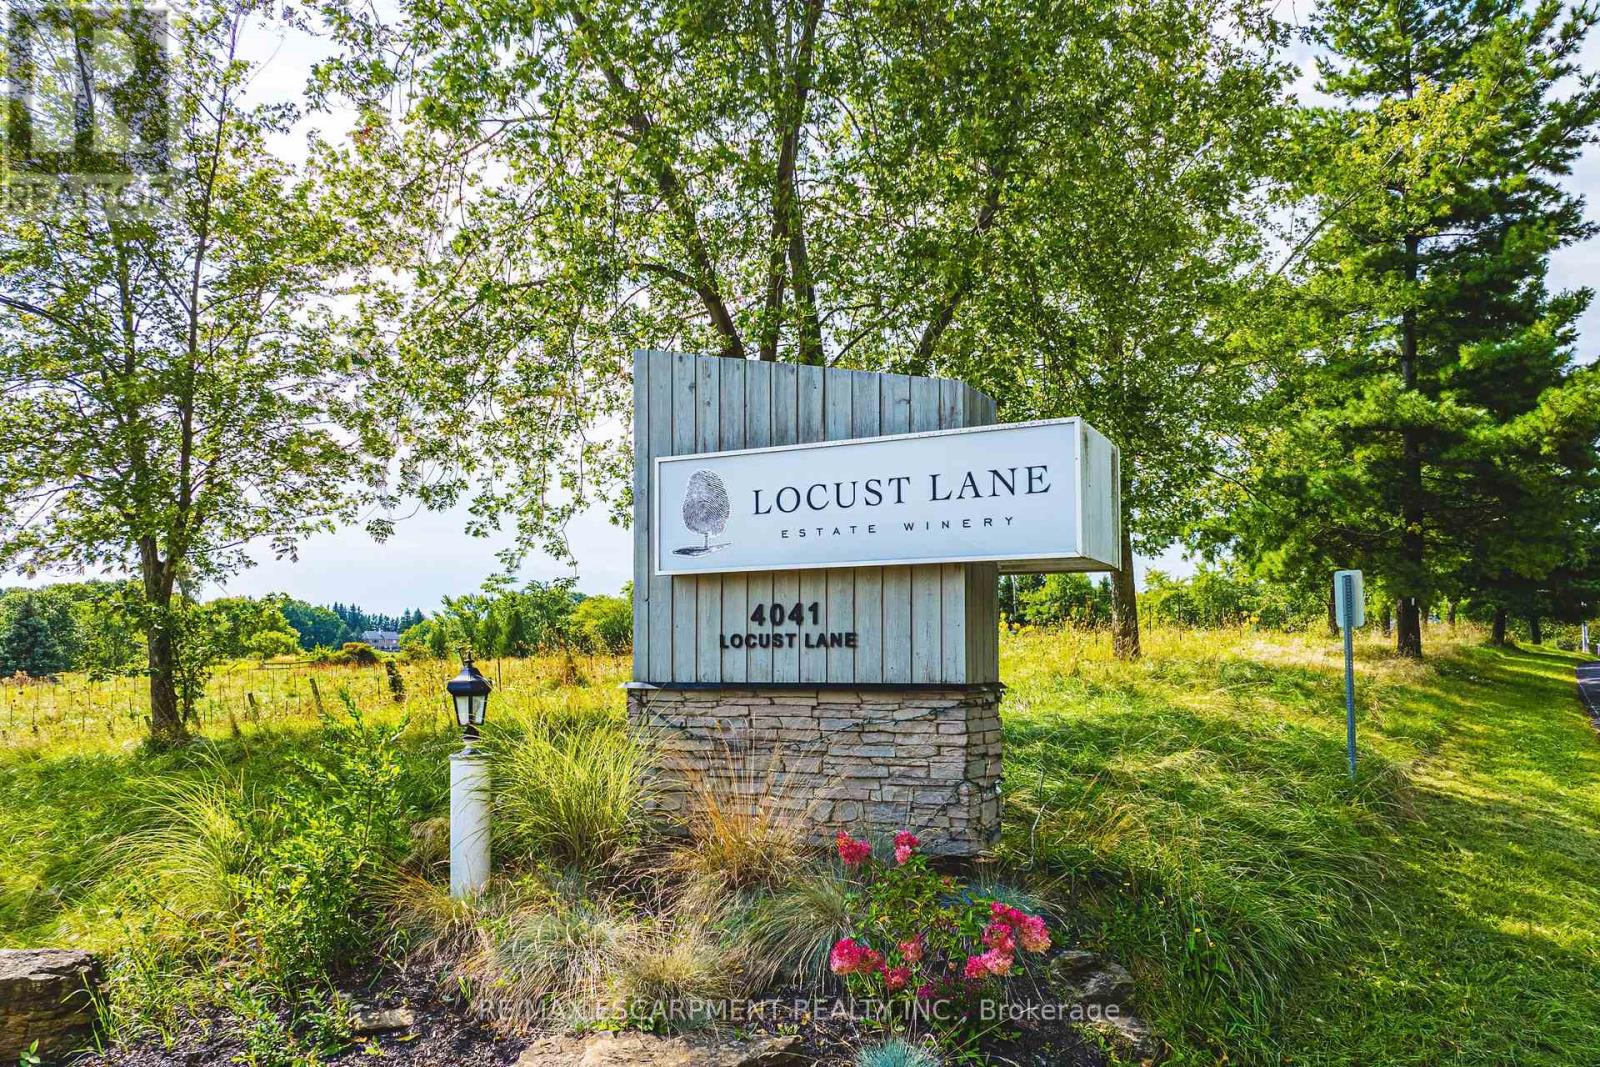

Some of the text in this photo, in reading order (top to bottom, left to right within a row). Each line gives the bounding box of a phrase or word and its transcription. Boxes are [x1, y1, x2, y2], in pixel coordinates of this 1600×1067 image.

[752, 465, 1051, 516] LOCUST LANE
[781, 516, 1014, 539] ESTATE WINERY
[750, 602, 820, 627] 4041
[719, 632, 859, 649] LOCUST LANE
